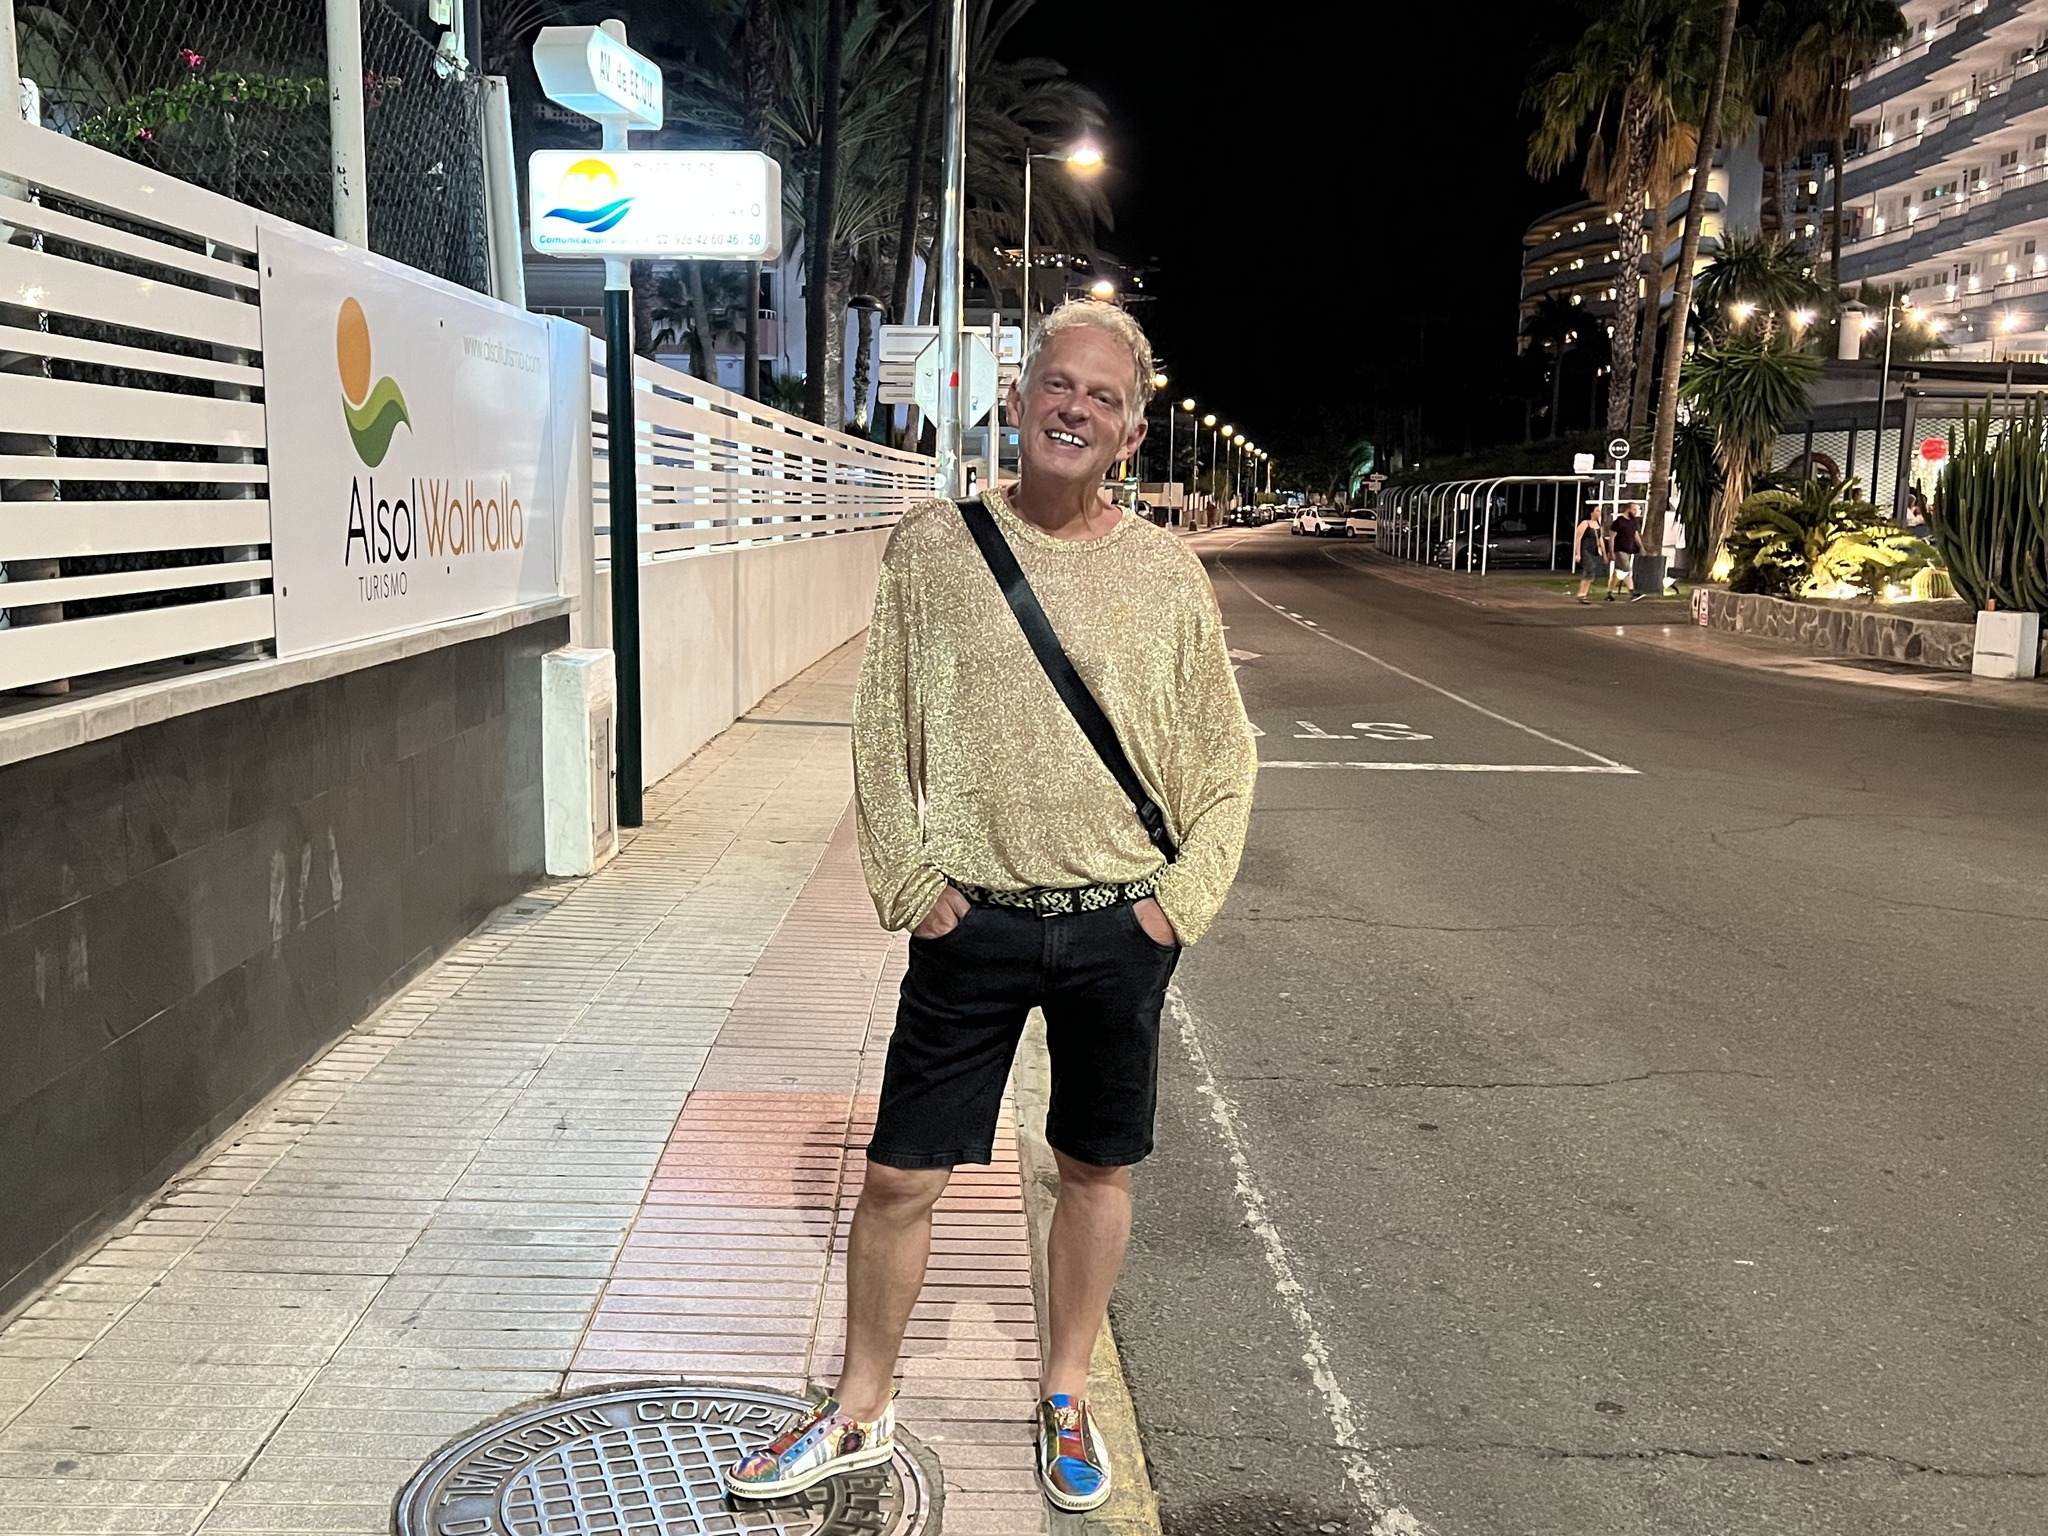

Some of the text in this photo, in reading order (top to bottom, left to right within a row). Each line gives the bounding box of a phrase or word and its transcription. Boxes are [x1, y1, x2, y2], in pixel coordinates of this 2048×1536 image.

[617, 61, 627, 92] de
[711, 234, 724, 246] 60
[749, 234, 761, 246] 50
[344, 474, 524, 567] Alsol Walhalla
[358, 571, 409, 603] TURISMO
[636, 1400, 794, 1432] COMPA
[439, 1409, 613, 1506] NACIONAL
